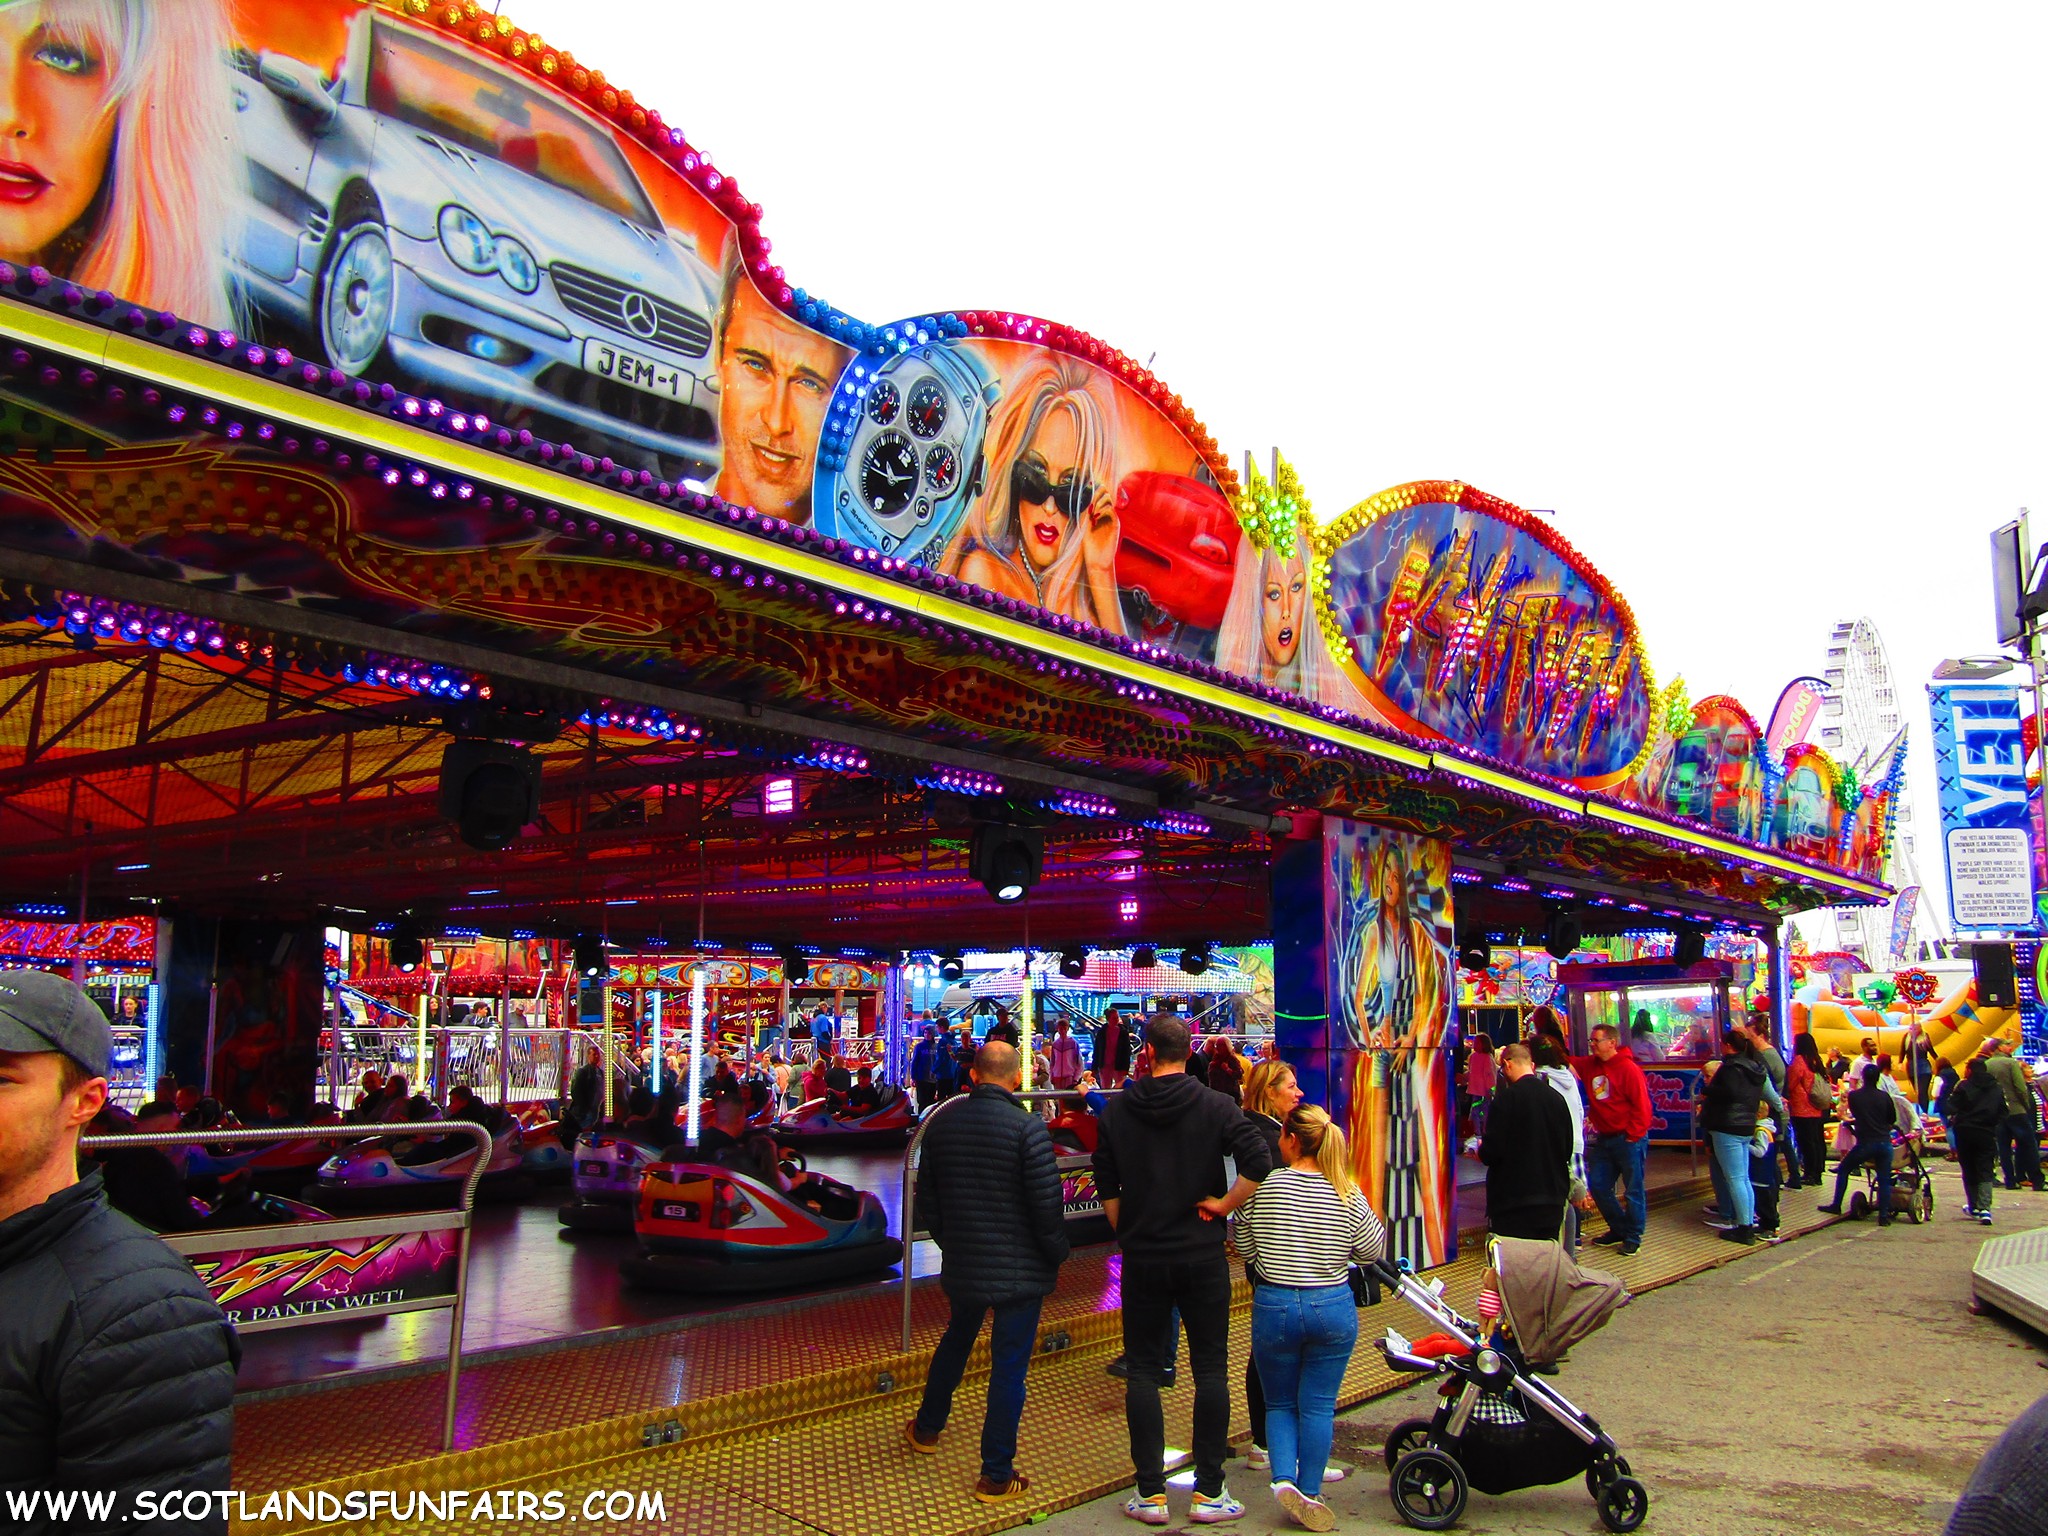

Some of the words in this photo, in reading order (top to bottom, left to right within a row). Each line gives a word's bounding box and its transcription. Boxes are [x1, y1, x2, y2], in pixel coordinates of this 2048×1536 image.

[598, 346, 678, 396] JEM-1
[898, 449, 911, 468] 12
[1949, 688, 2027, 817] YETI
[733, 996, 776, 1007] LIGTNING
[252, 1297, 337, 1322] PANTS
[343, 1288, 405, 1309] WET!
